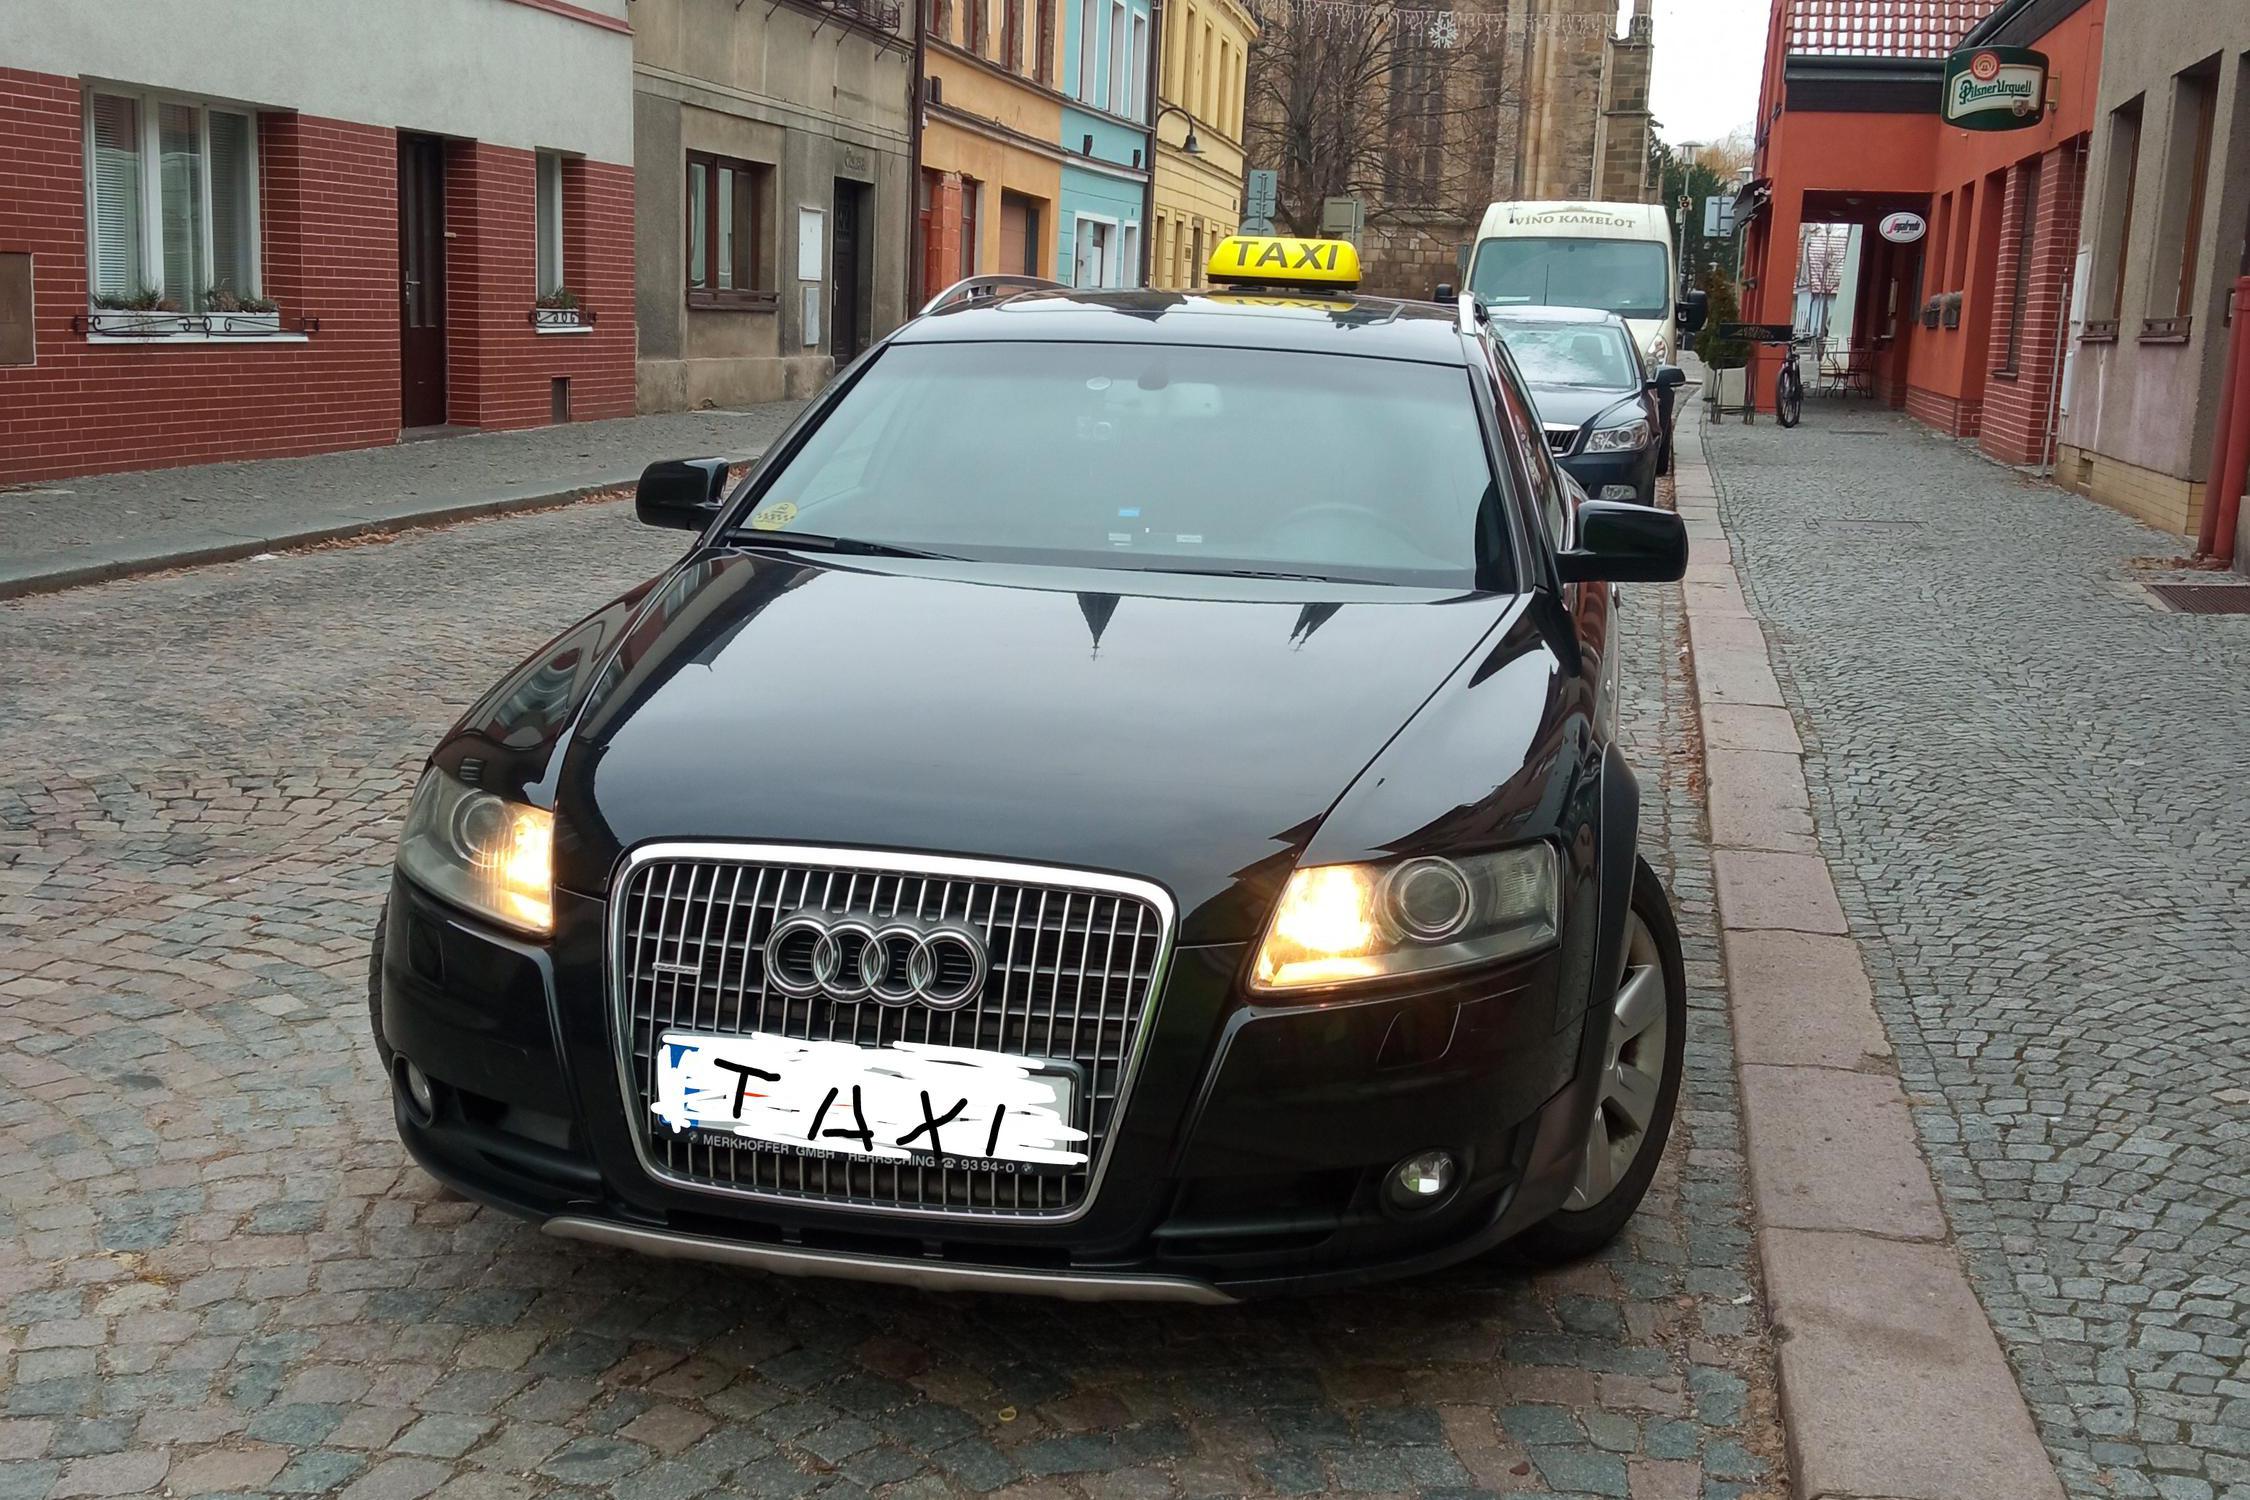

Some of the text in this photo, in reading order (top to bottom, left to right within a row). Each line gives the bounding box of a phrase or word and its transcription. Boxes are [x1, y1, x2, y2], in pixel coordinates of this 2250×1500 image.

[1959, 79, 2032, 105] Pilsner Urquell
[1560, 215, 1635, 228] KAMELOT
[1233, 240, 1338, 270] TAXI
[703, 1134, 790, 1155] MERKHOFFER
[796, 1146, 835, 1159] GMBH
